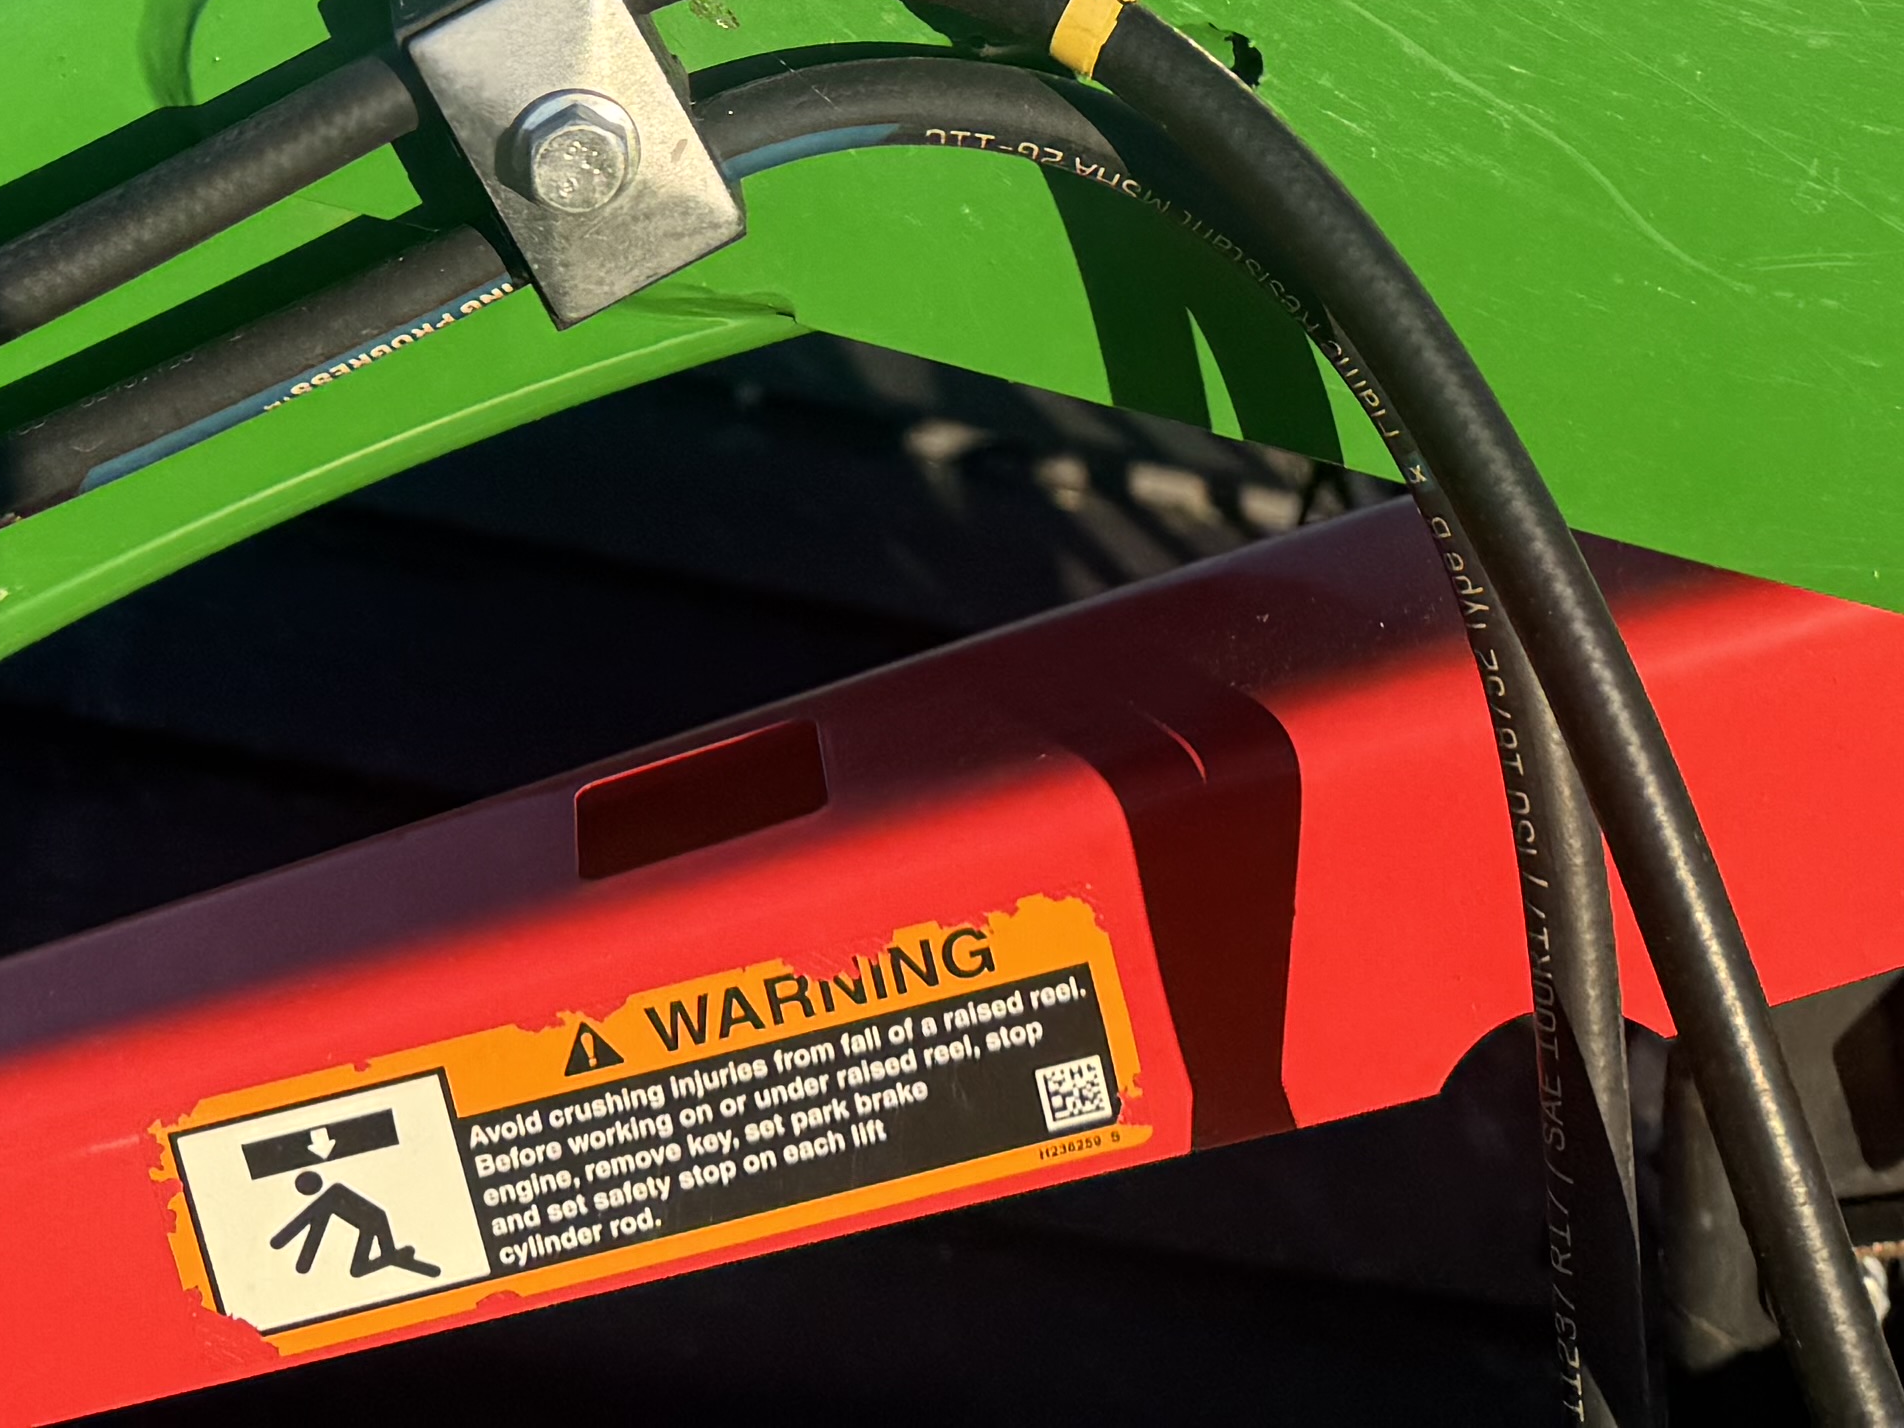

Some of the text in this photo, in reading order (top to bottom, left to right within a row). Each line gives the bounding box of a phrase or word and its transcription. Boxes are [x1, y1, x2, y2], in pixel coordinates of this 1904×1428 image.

[643, 926, 996, 1052] WARNING
[470, 975, 1087, 1150] Avoid crushing injuries from fall of a raised reel.
[474, 1020, 1044, 1179] Before working on or under raised reel, stop
[483, 1080, 929, 1207] engine, remove key, set park brake
[491, 1117, 888, 1236] and set safety stop on each lift
[498, 1206, 662, 1268] cylinder rod.
